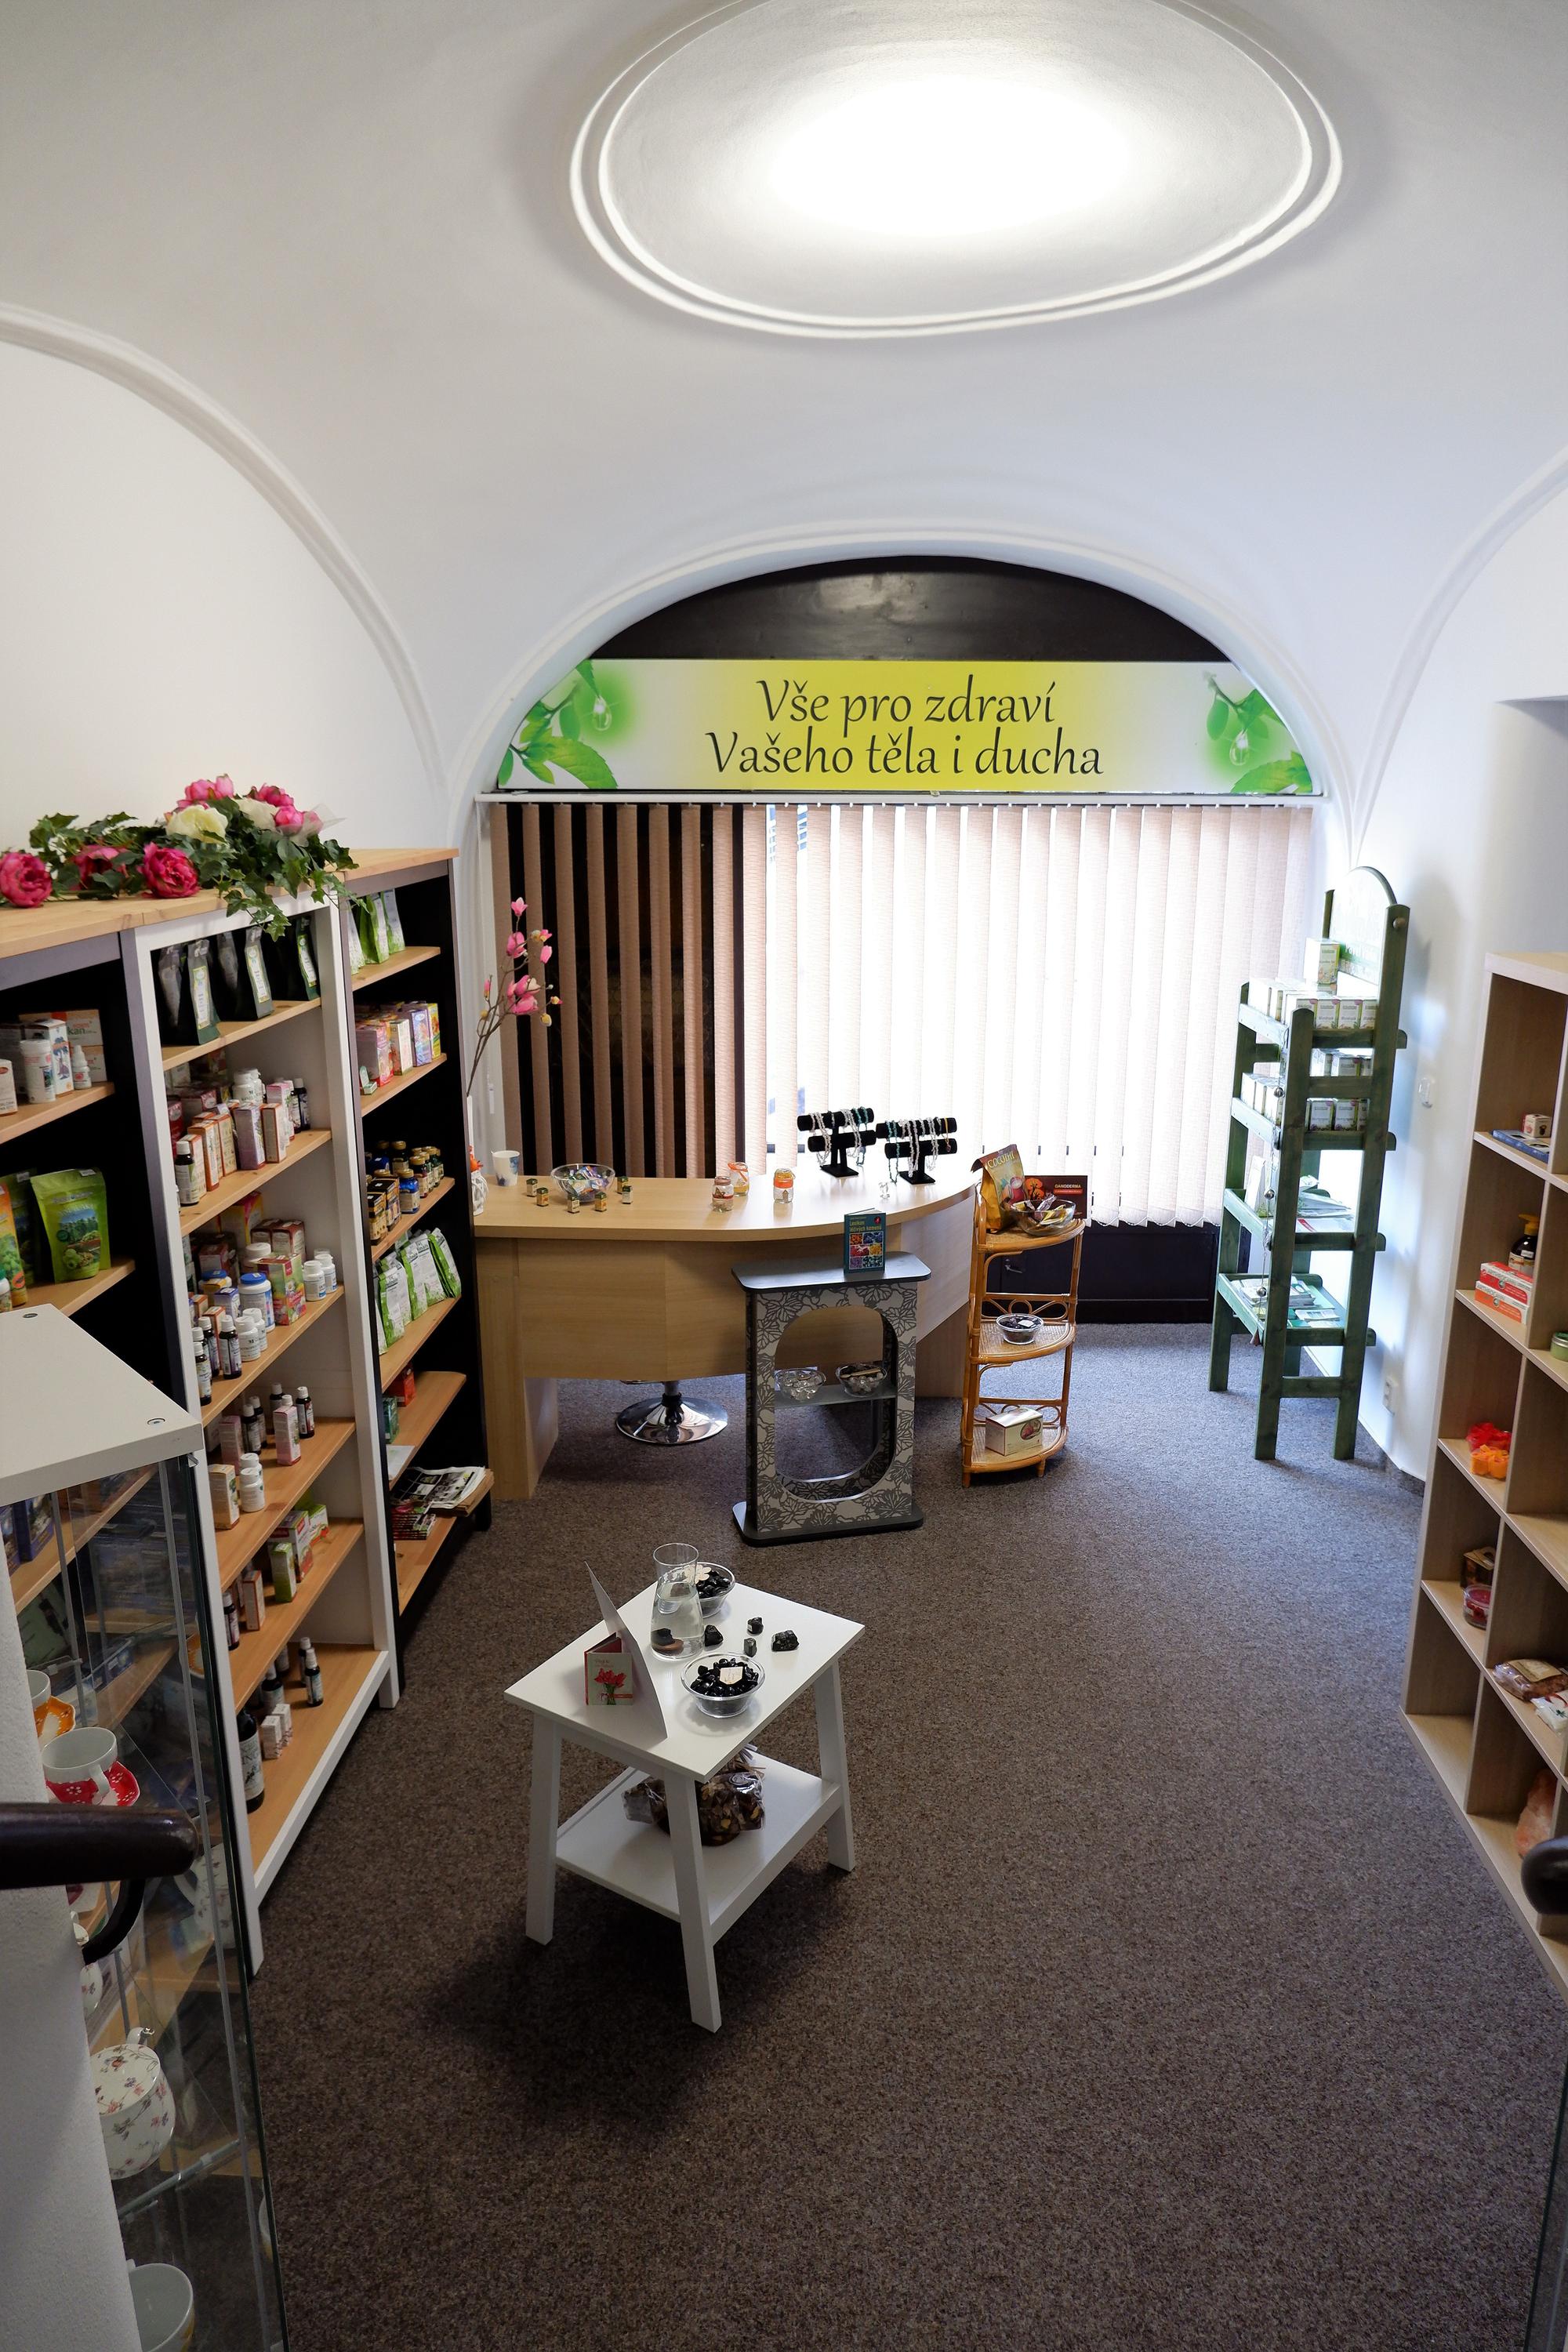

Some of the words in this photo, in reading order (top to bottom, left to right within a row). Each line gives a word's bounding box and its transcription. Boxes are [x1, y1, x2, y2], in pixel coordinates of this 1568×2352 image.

[756, 679, 829, 722] Vše
[840, 695, 912, 738] pro
[924, 673, 1056, 723] zdraví
[705, 725, 854, 774] Vašeho
[866, 725, 940, 774] těla
[953, 735, 964, 774] i
[975, 726, 1104, 775] ducha
